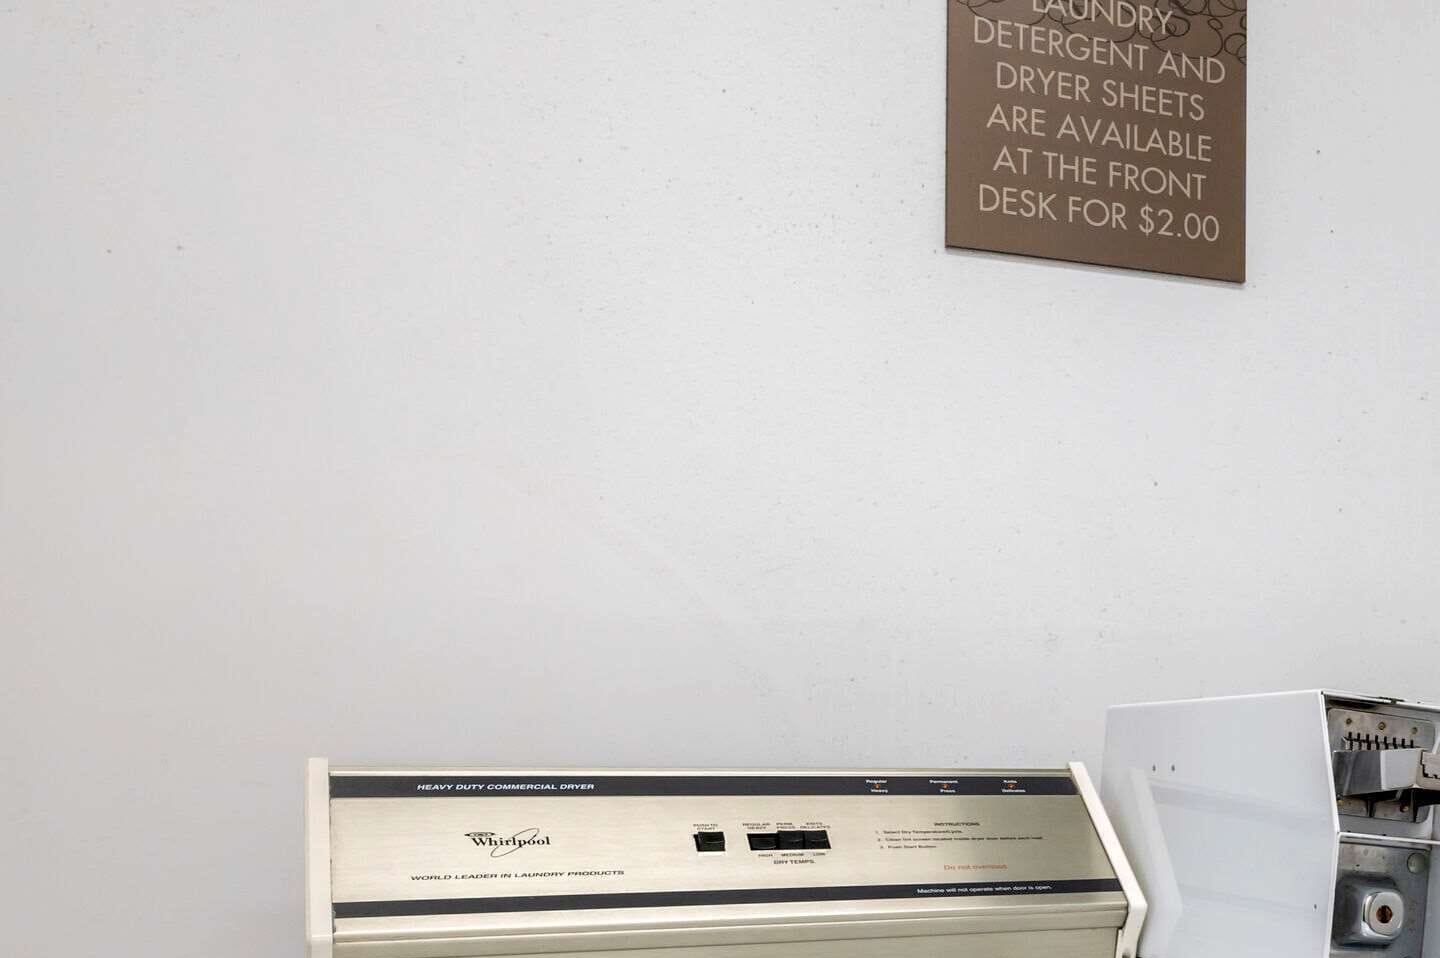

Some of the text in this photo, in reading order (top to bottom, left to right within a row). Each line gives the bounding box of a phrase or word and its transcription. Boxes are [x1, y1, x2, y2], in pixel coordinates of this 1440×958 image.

[974, 15, 1226, 84] DETERGENT AND
[996, 61, 1205, 121] DRYER SHEETS
[986, 103, 1212, 162] ARE AVAILABLE
[993, 145, 1207, 200] AT THE FRONT
[979, 184, 1220, 242] DESK FOR $2.00
[917, 887, 945, 895] Machine
[969, 886, 993, 894] operate
